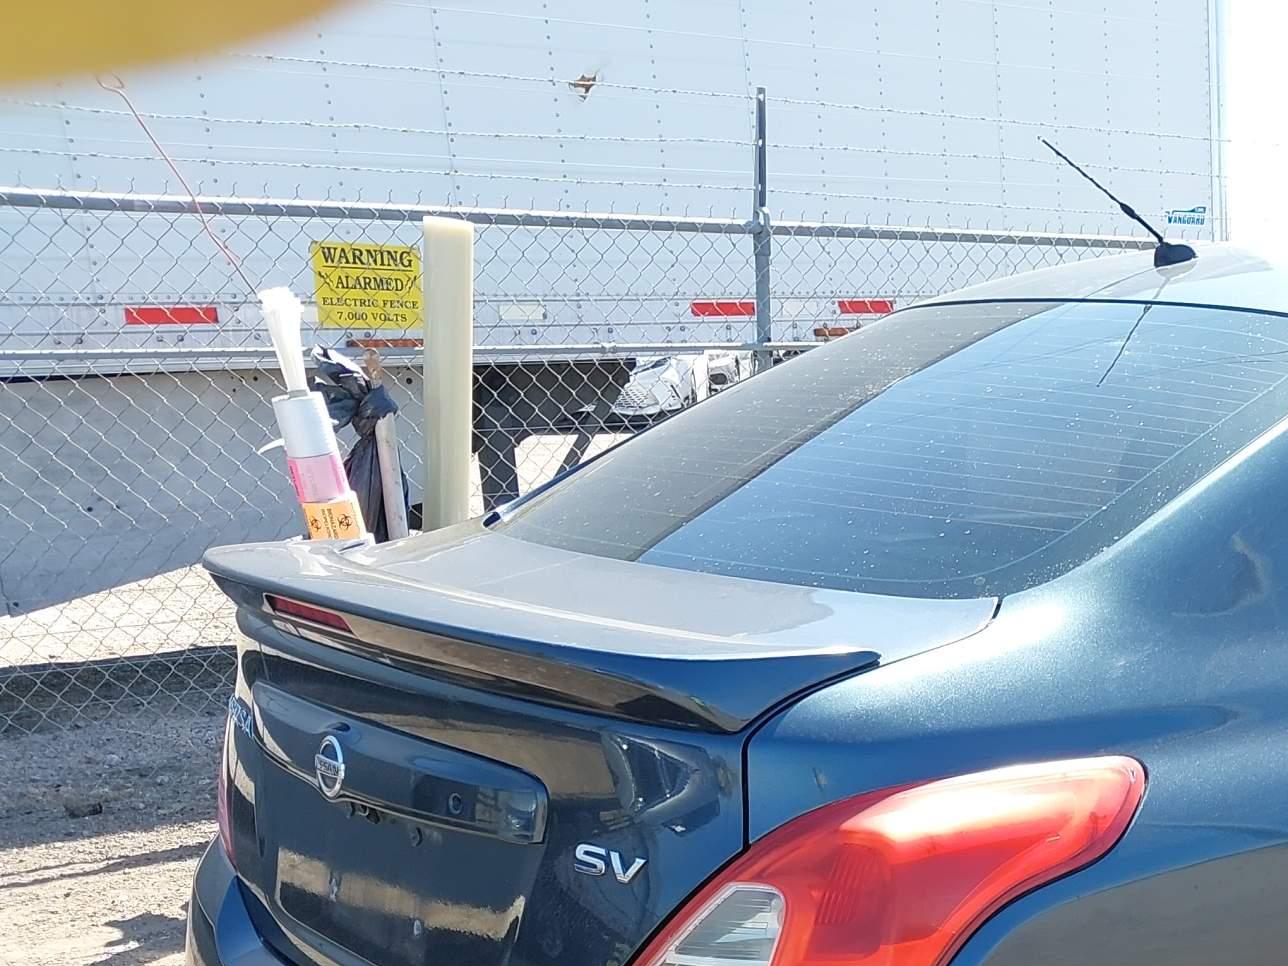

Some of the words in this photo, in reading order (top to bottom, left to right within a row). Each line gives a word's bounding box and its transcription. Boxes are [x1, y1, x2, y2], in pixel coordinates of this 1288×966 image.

[1167, 215, 1205, 225] VANGUARD
[320, 246, 414, 269] WARNING
[335, 275, 404, 292] ALARMED
[321, 296, 380, 308] ELECTRIC
[382, 299, 419, 310] FENCE
[371, 312, 408, 323] VOLTS
[574, 843, 647, 883] SV
